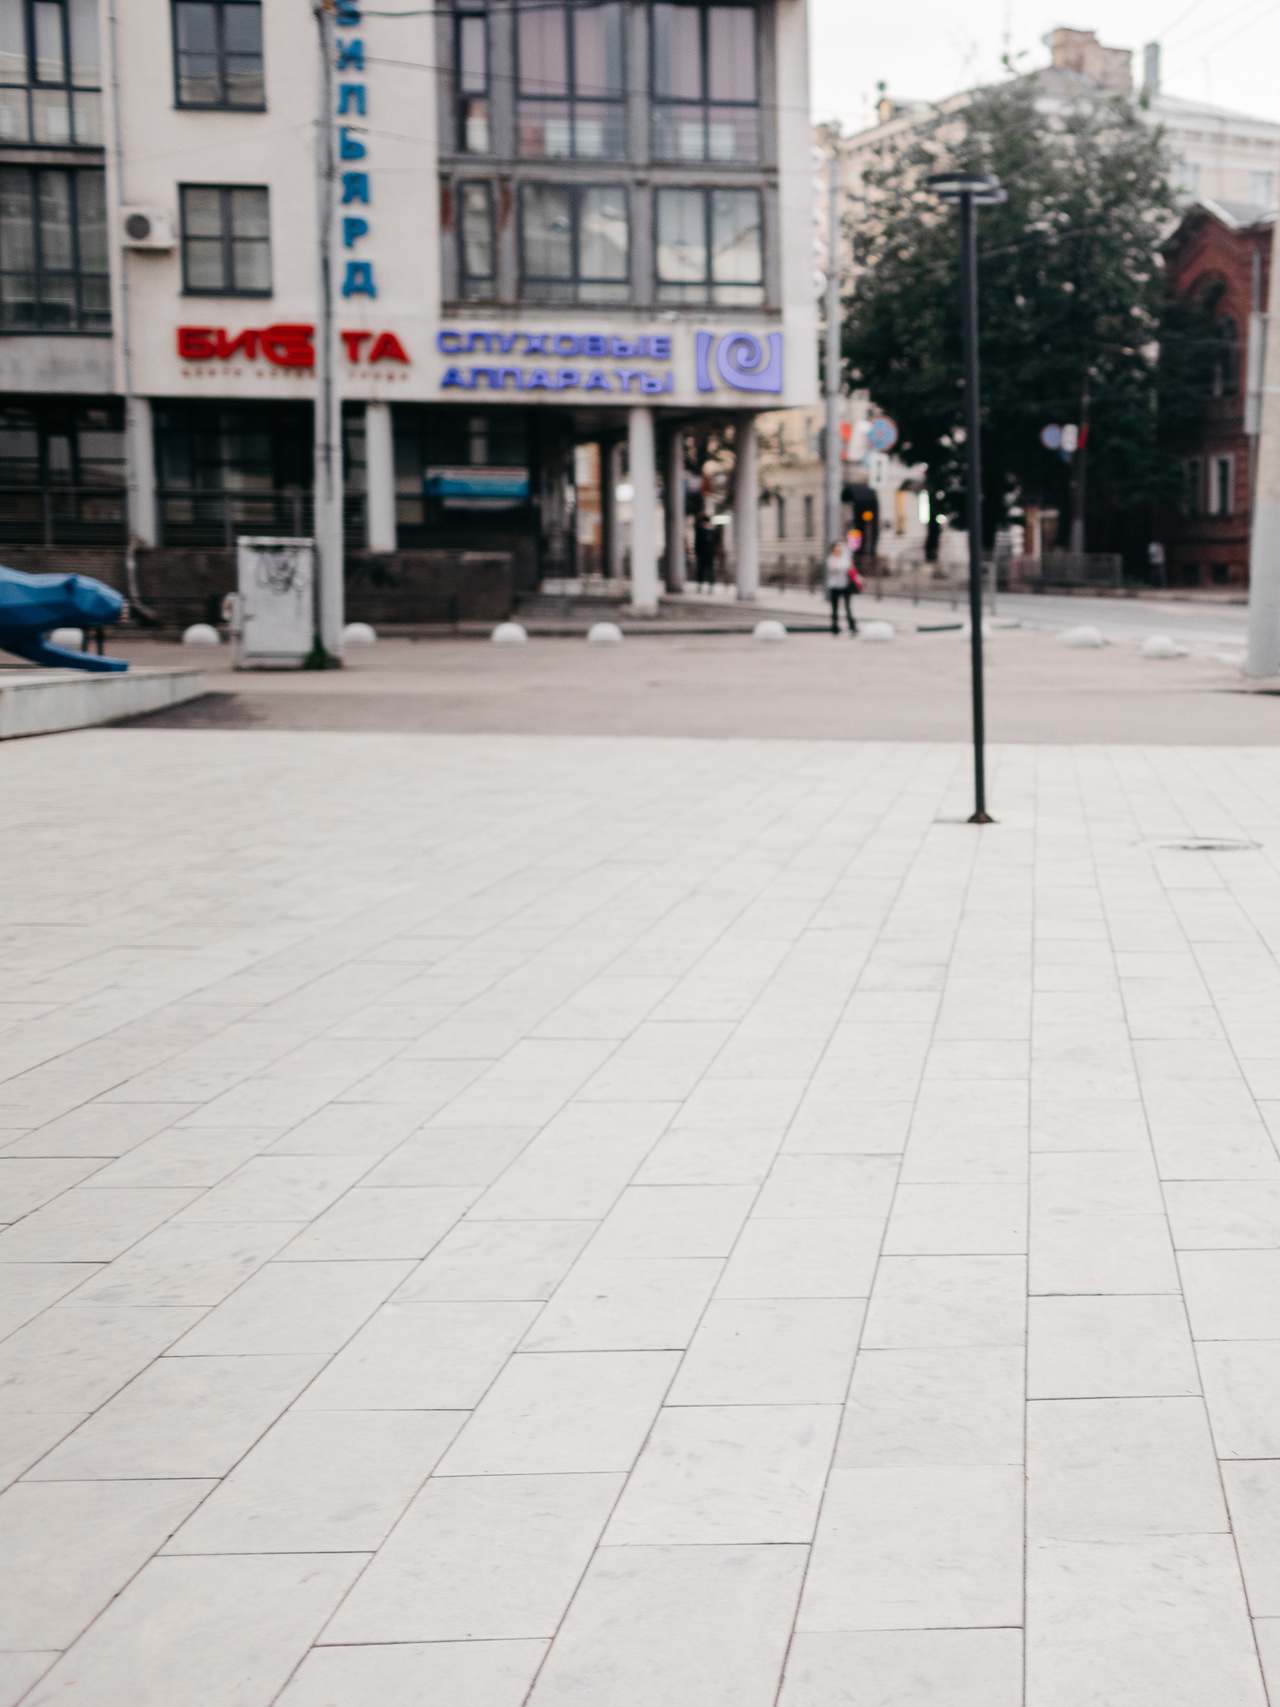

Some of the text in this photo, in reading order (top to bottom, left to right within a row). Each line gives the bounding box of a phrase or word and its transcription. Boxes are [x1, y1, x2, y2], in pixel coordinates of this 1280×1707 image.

[335, 0, 377, 299] БИЛЬЯРД
[437, 329, 672, 359] СЛУХОВЫЕ
[440, 366, 674, 394] АППАРАТЫ
